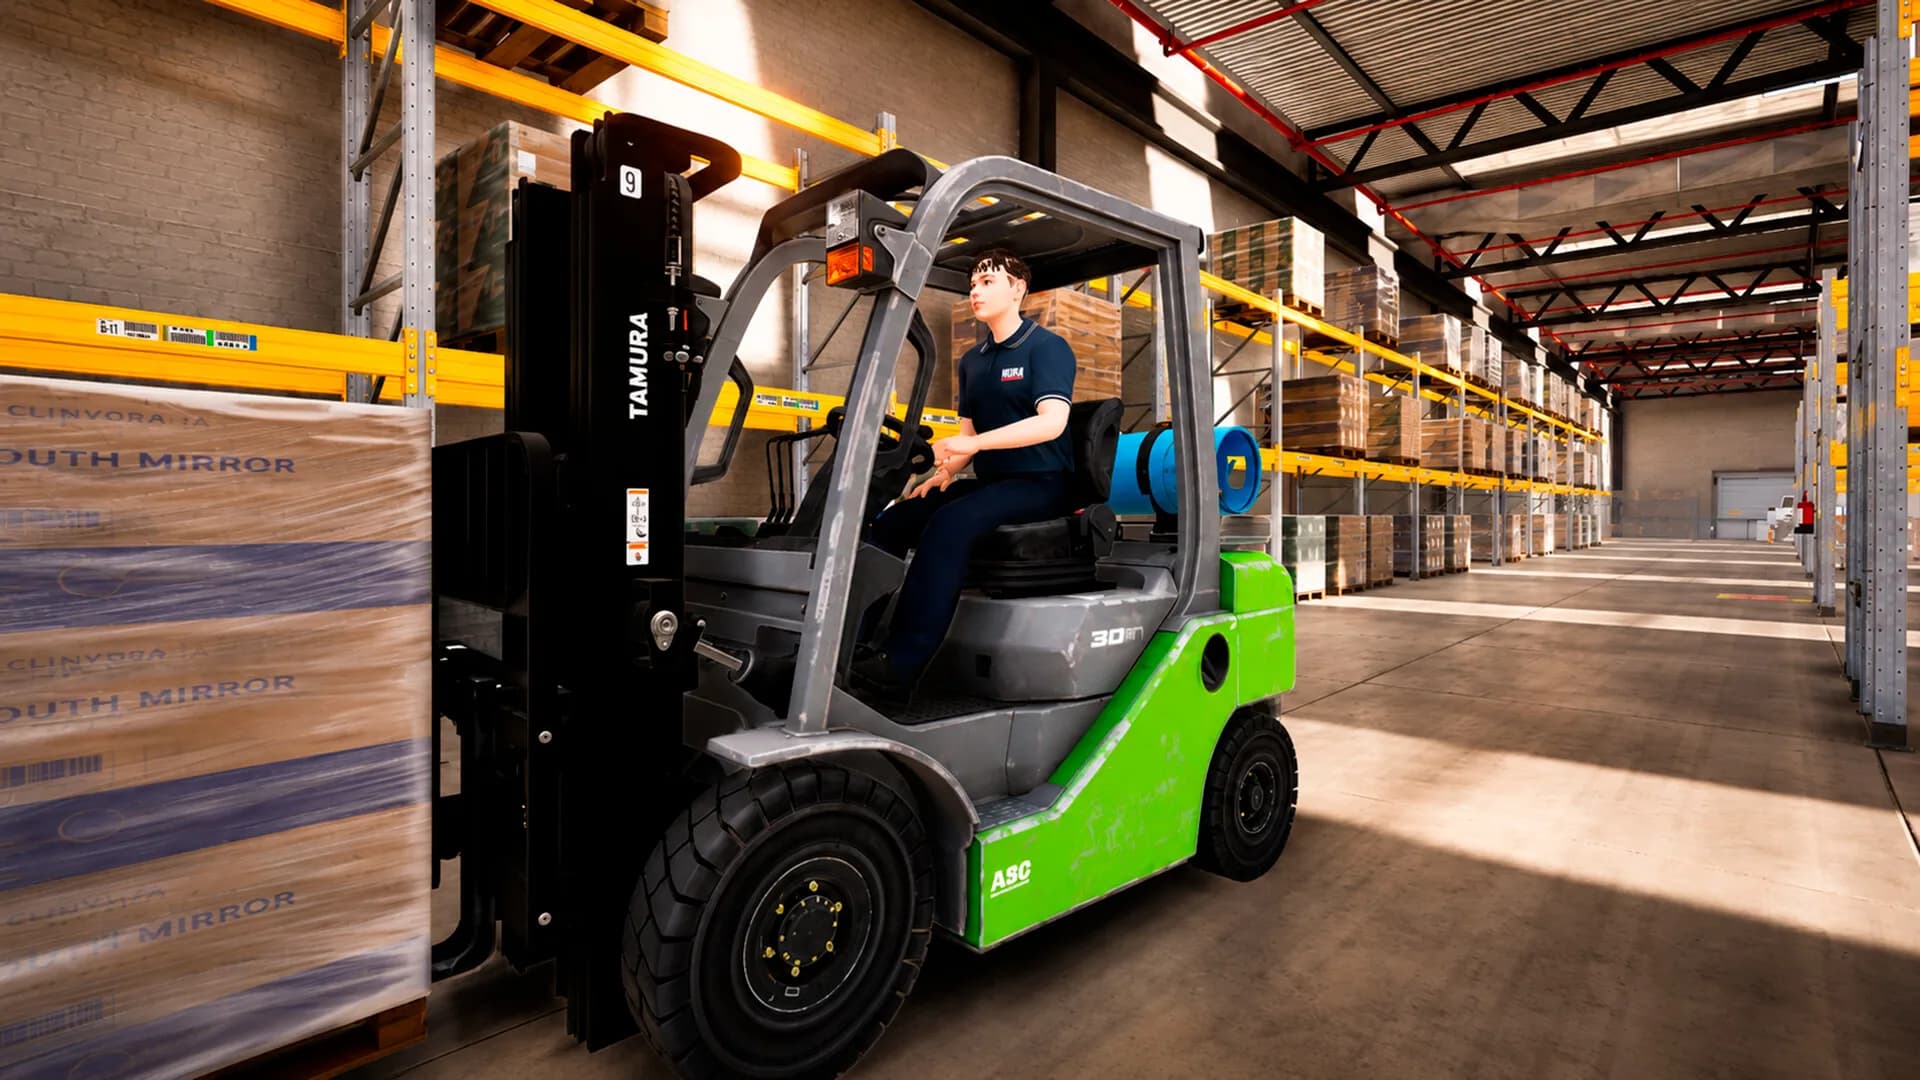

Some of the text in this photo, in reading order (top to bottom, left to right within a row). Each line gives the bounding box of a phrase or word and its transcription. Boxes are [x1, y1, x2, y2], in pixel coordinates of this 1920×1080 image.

[626, 171, 635, 193] 9
[629, 312, 648, 420] TAMURA
[7, 404, 166, 425] CLINVORA
[139, 452, 296, 473] MIRROR
[139, 675, 296, 708] MIRROR
[990, 859, 1031, 893] ASC
[138, 890, 296, 944] MIRROR
